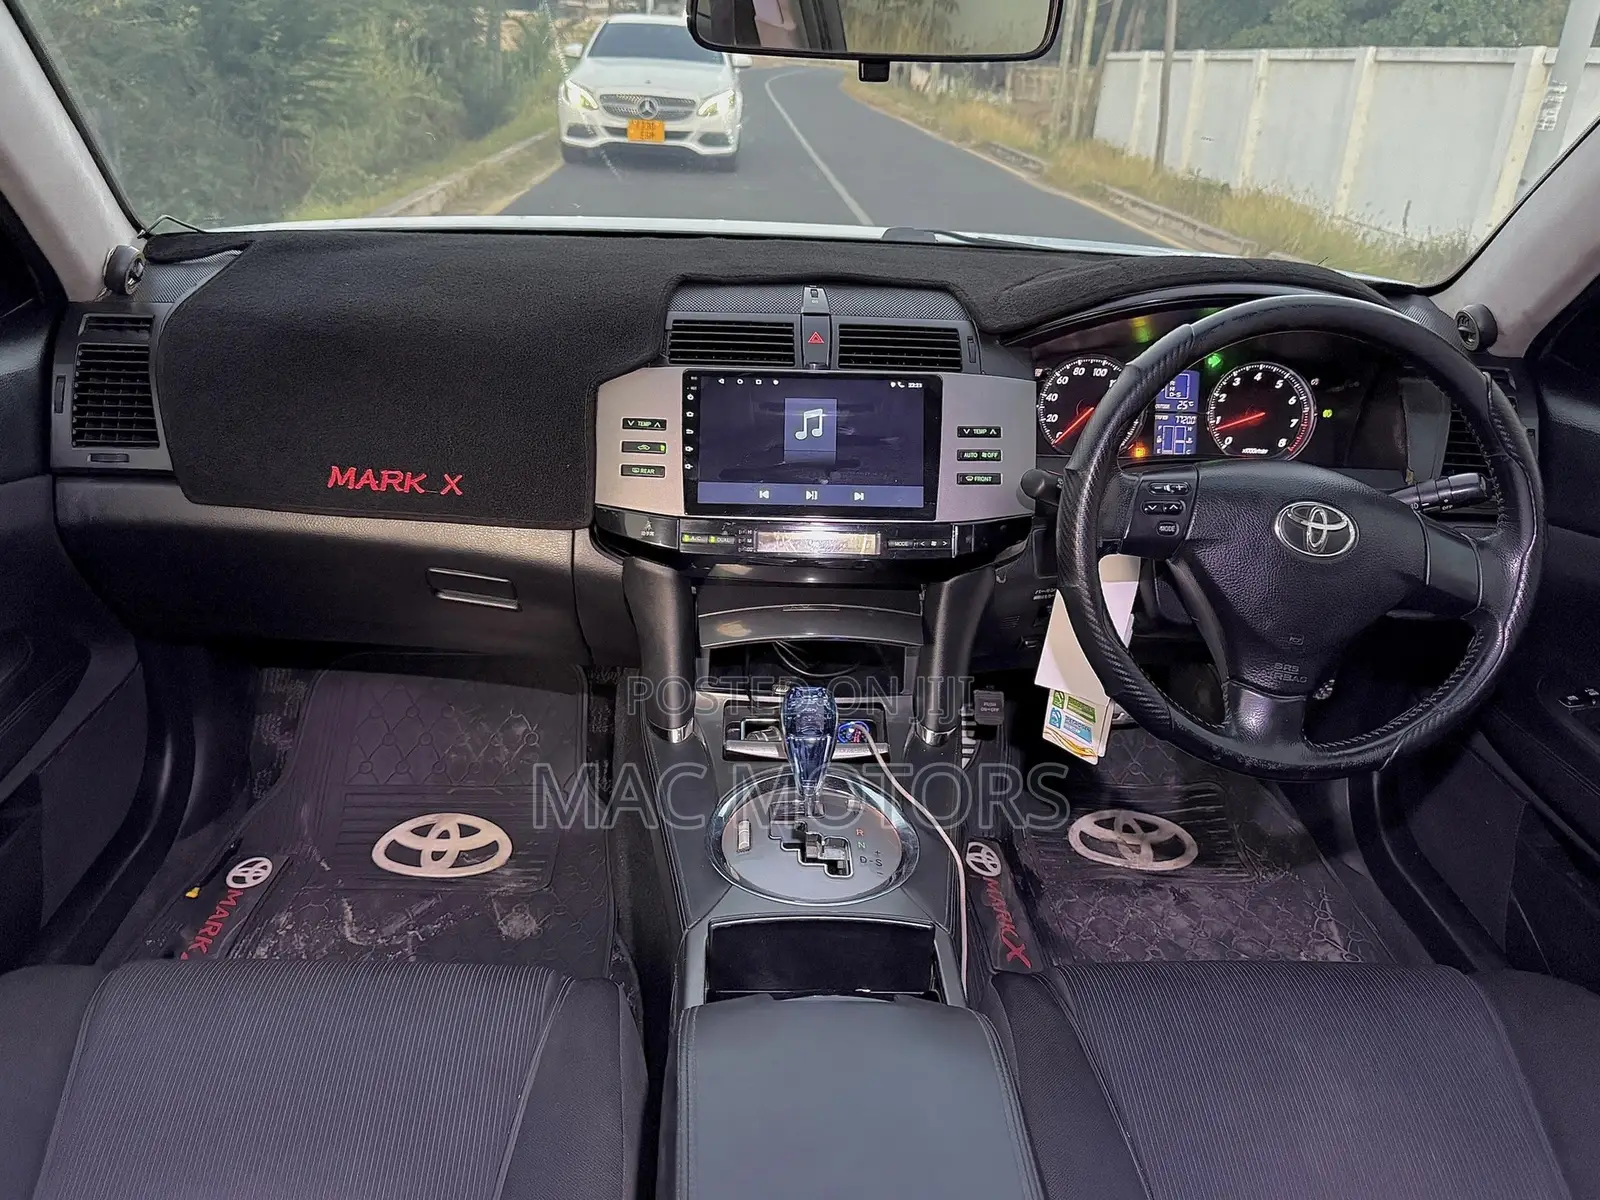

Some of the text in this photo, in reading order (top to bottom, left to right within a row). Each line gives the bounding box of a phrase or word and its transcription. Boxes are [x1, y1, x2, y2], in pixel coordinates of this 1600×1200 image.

[1072, 367, 1086, 376] 80
[1092, 367, 1108, 377] 100
[1056, 376, 1069, 385] 60
[1253, 372, 1263, 381] 4
[1232, 377, 1242, 386] 3
[1274, 379, 1284, 389] 5
[1045, 393, 1059, 402] 40
[1217, 393, 1227, 402] 2
[1287, 396, 1297, 405] 6
[1045, 414, 1059, 423] 20
[1215, 415, 1222, 425] 1
[1289, 418, 1299, 428] 7
[1224, 436, 1233, 445] 0
[1277, 438, 1287, 448] 8
[327, 466, 463, 496] MARK X
[1160, 525, 1176, 533] MODE
[856, 828, 864, 837] R
[857, 841, 867, 849] N
[188, 888, 244, 954] MARK
